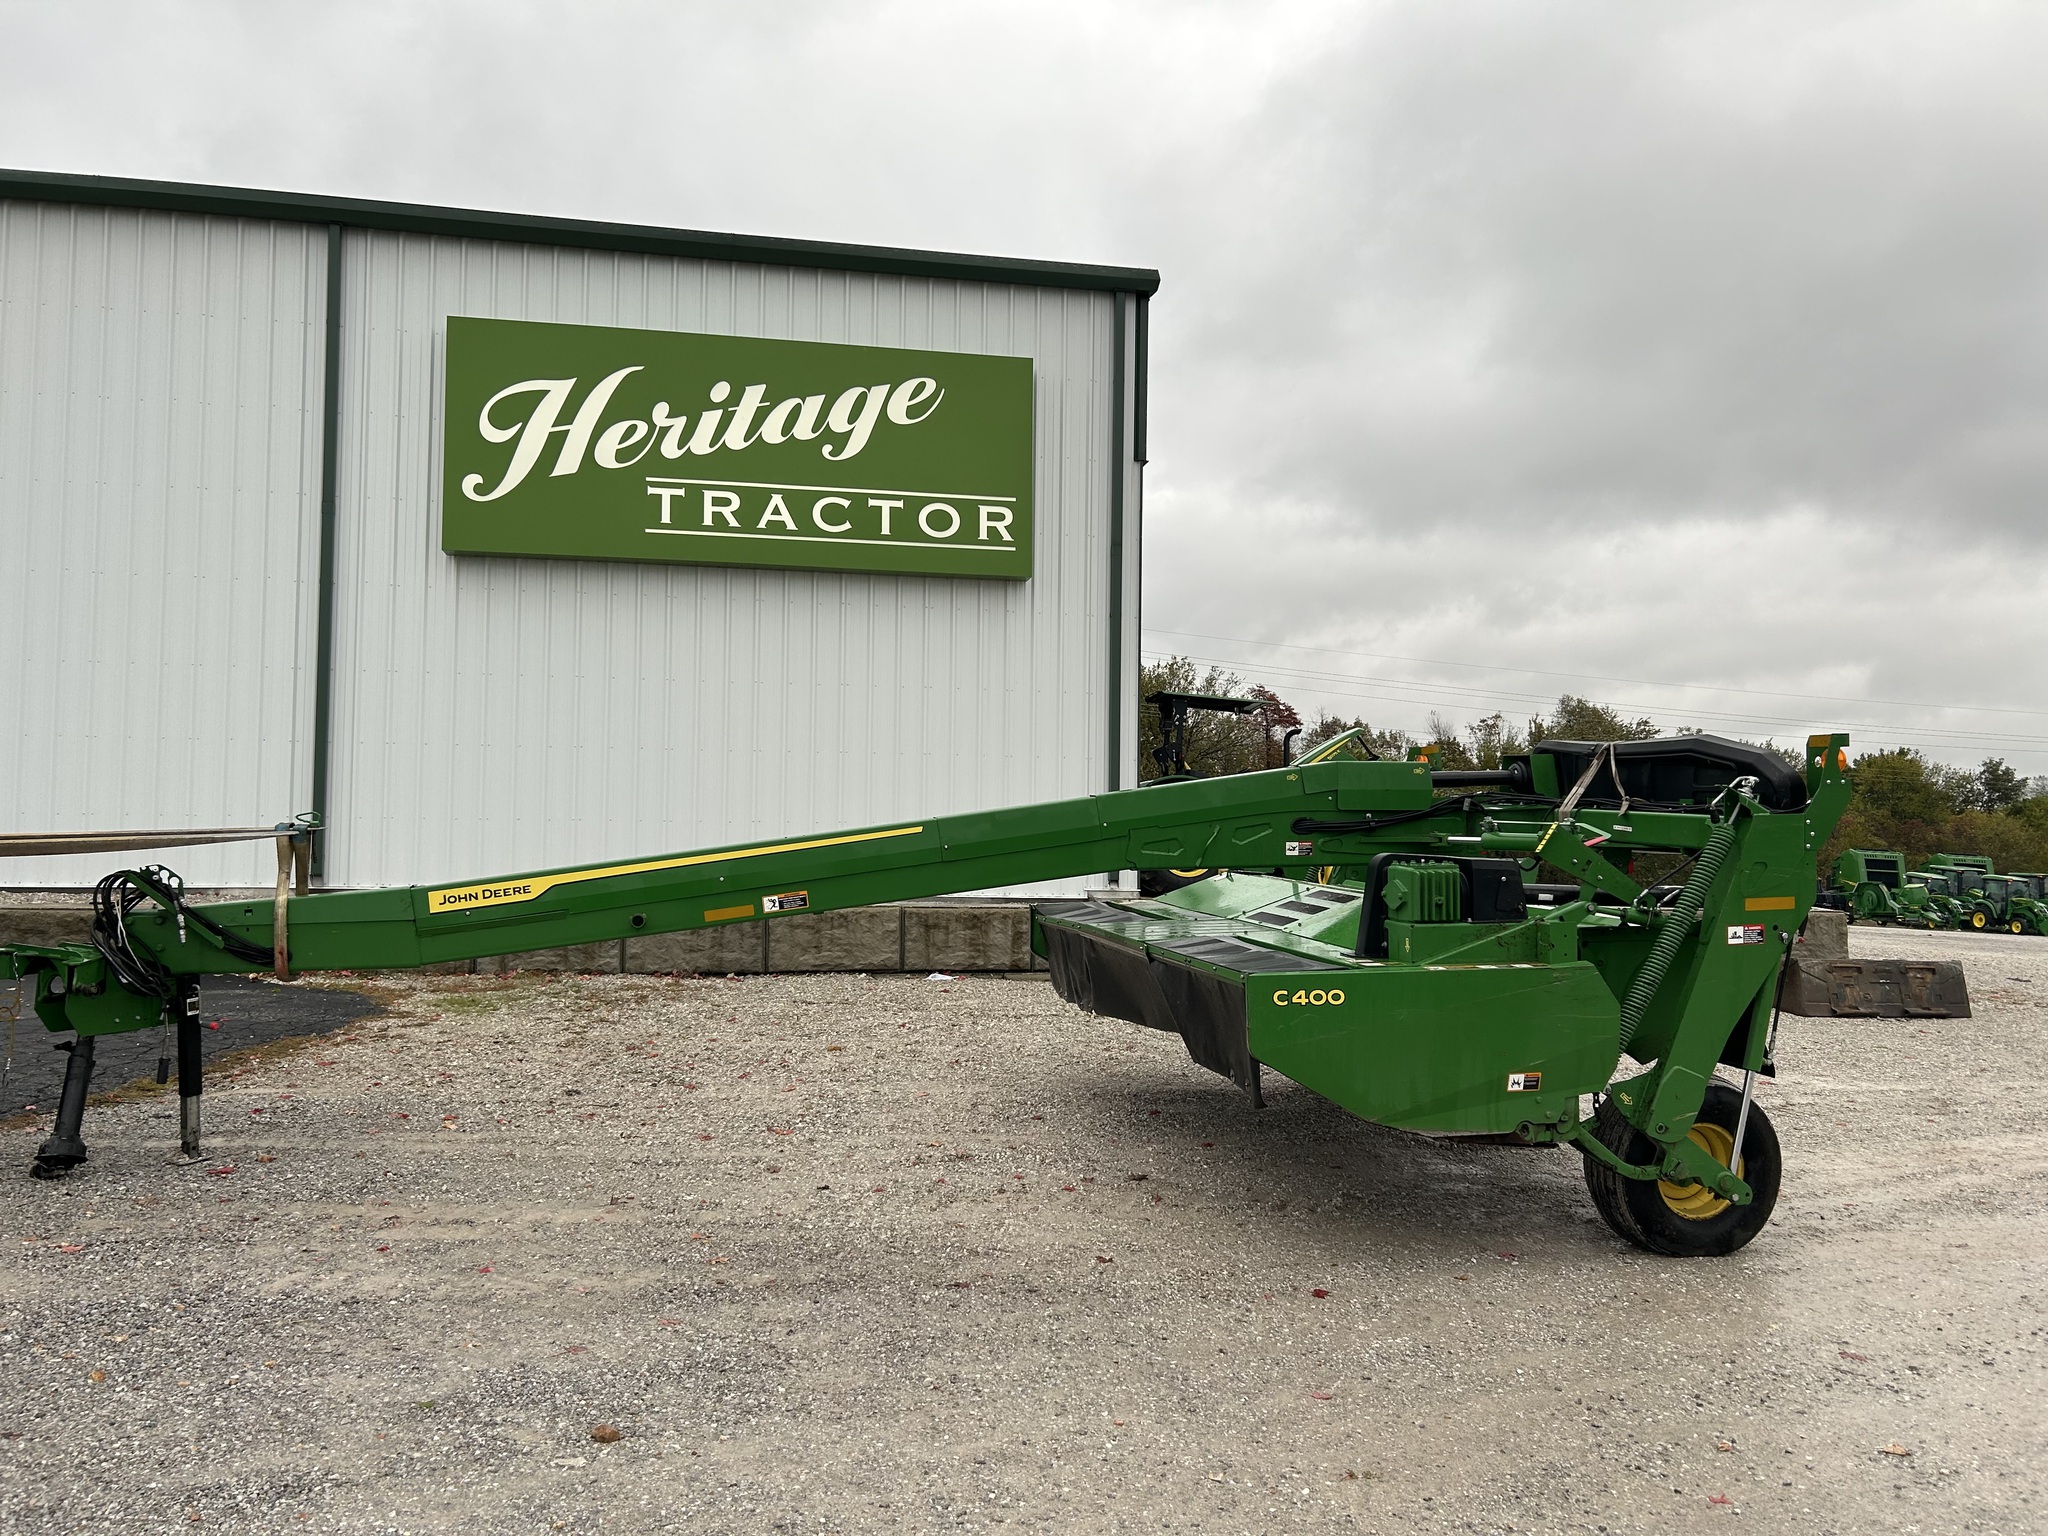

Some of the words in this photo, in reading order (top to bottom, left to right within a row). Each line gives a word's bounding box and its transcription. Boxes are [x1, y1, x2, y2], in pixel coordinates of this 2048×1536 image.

[461, 365, 945, 502] Heritage
[646, 485, 1015, 542] TRACTOR
[438, 891, 480, 907] JOHN
[481, 884, 532, 900] DEERE
[1273, 989, 1345, 1006] C400
